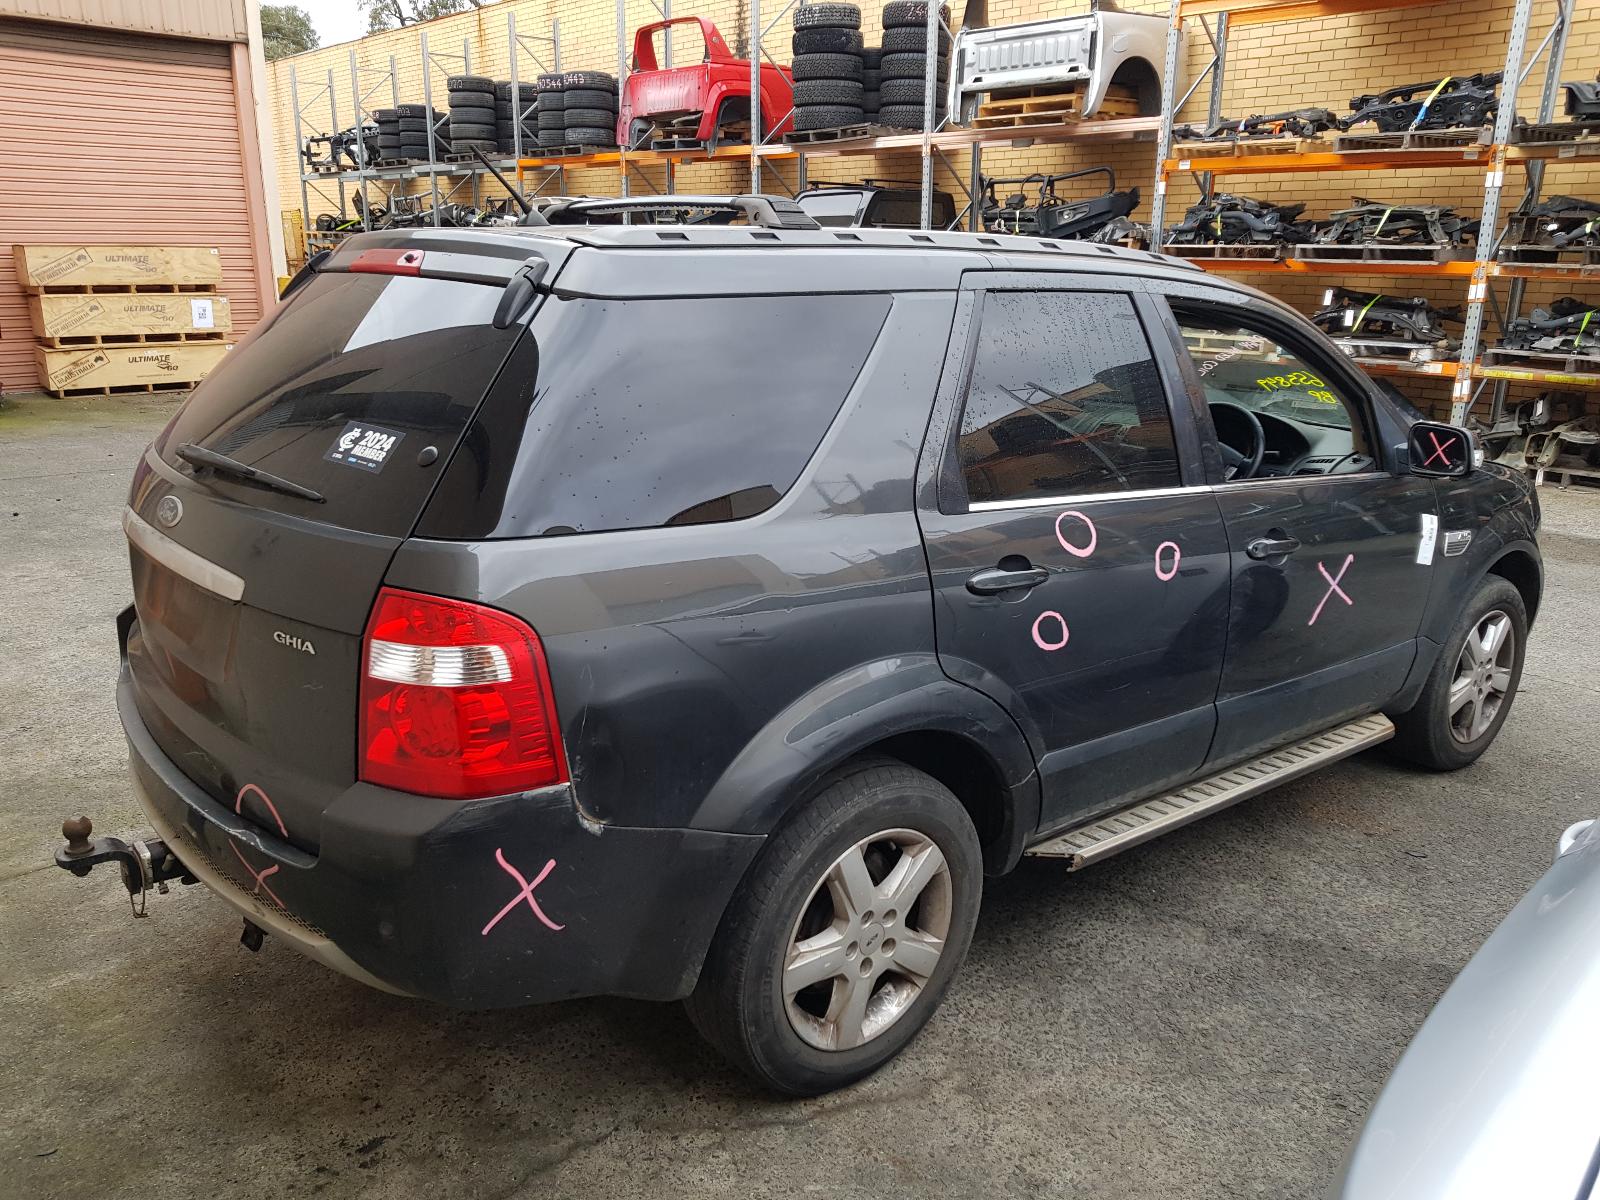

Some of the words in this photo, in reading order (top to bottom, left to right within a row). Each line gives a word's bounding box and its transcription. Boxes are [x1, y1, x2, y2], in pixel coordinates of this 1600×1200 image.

[105, 255, 149, 263] ULTIMATE
[123, 304, 166, 313] ULTIMATE
[128, 355, 170, 364] ULTIMATE
[64, 362, 96, 383] AUSTRALIA
[358, 430, 397, 452] 2024
[350, 444, 387, 462] MEMBER
[273, 631, 316, 655] GHIA
